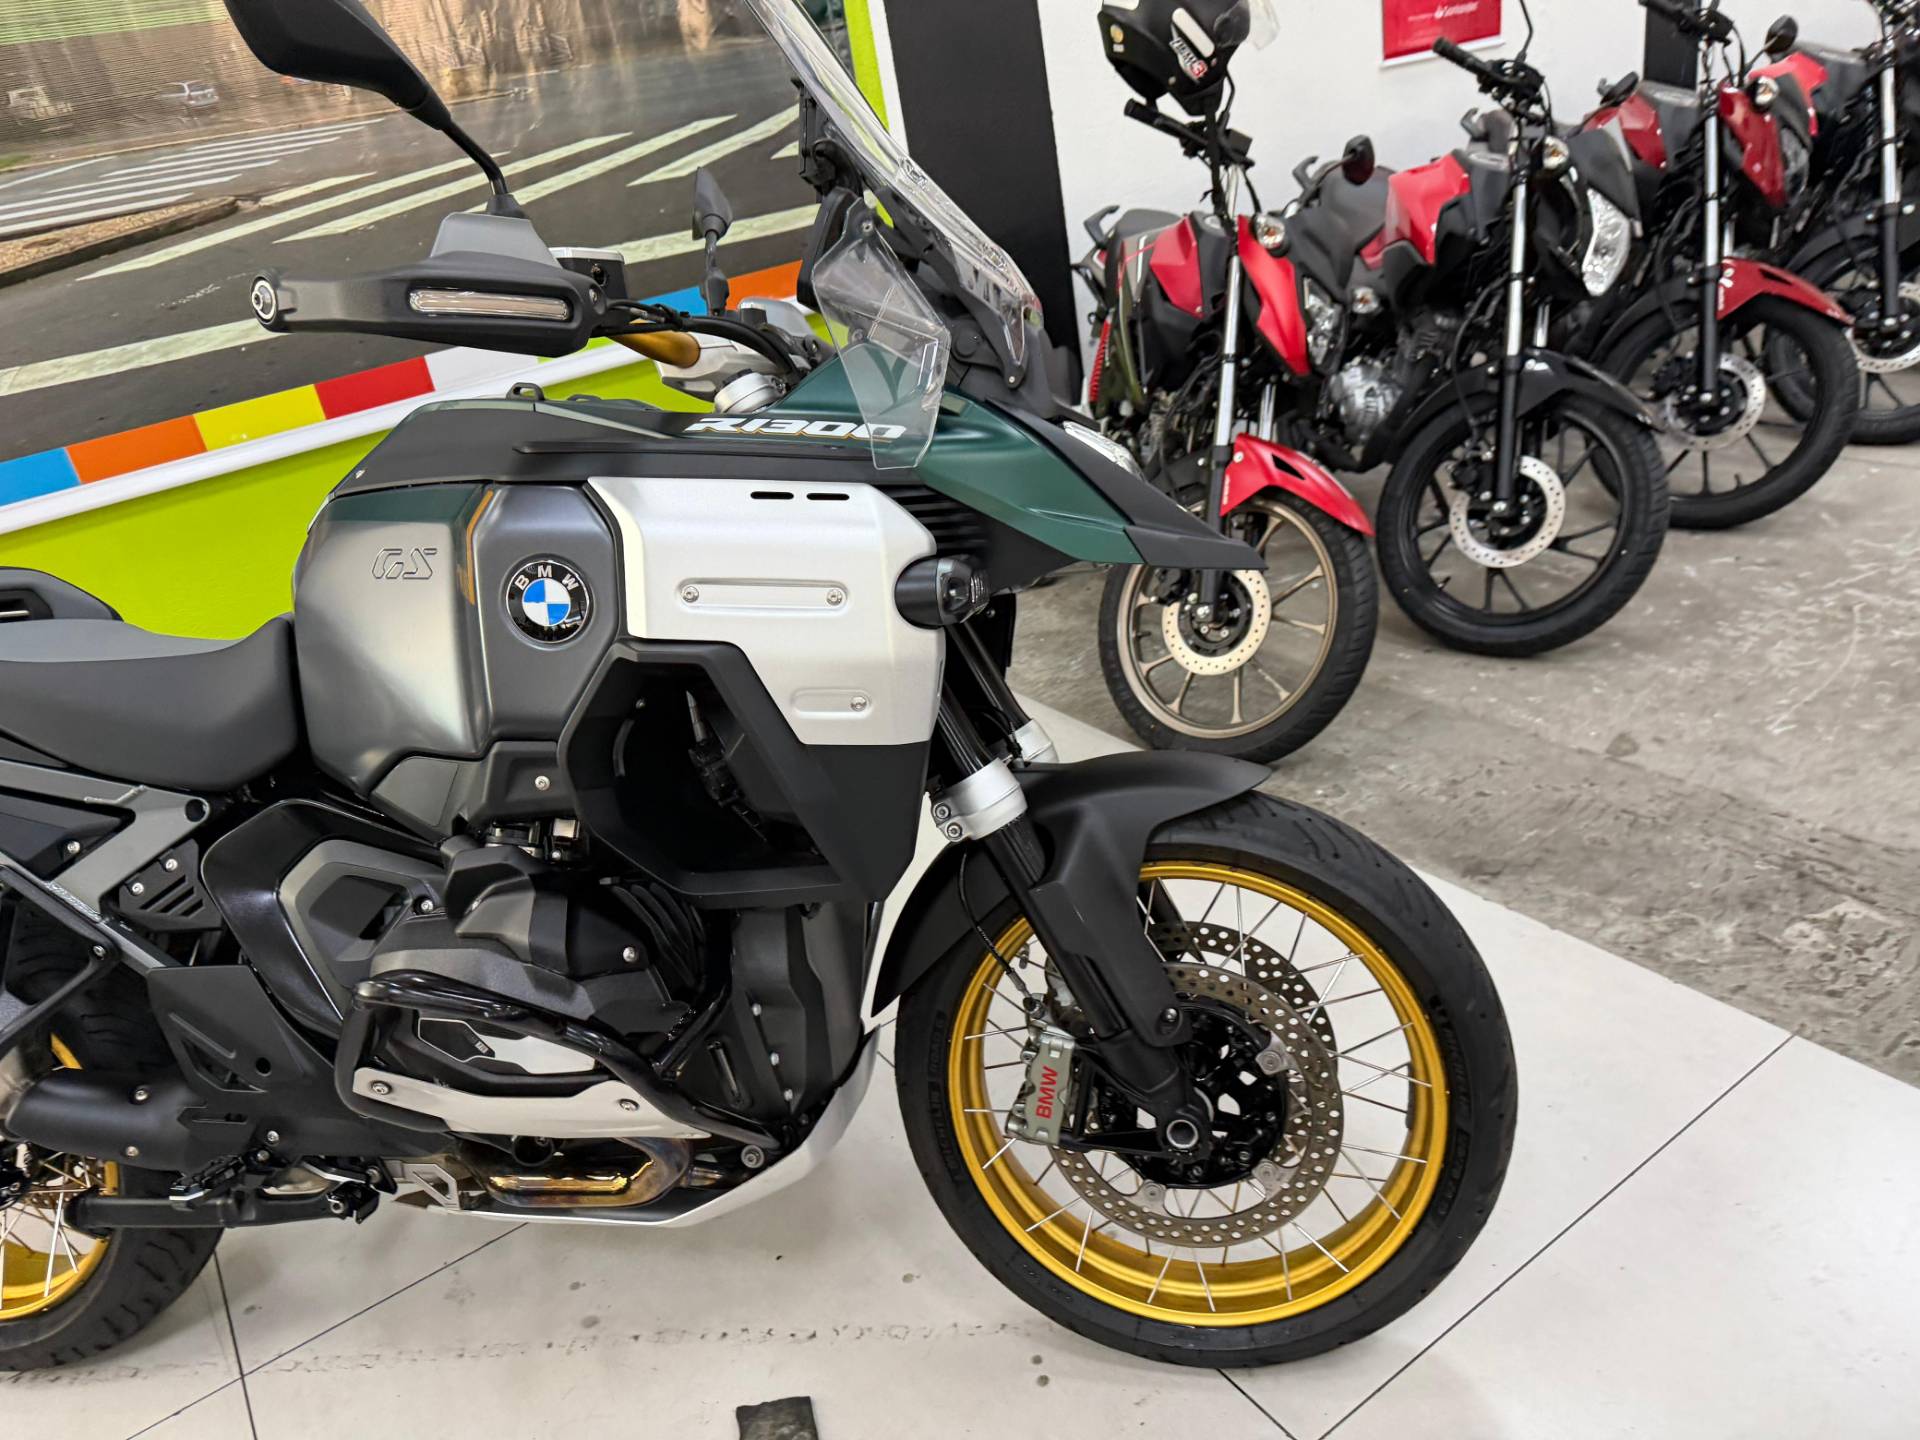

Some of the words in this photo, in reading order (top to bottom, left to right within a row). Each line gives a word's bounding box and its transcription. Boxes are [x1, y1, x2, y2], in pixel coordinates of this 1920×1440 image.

[371, 547, 437, 579] GS
[514, 564, 579, 591] BMW
[1035, 1066, 1060, 1119] BMW
